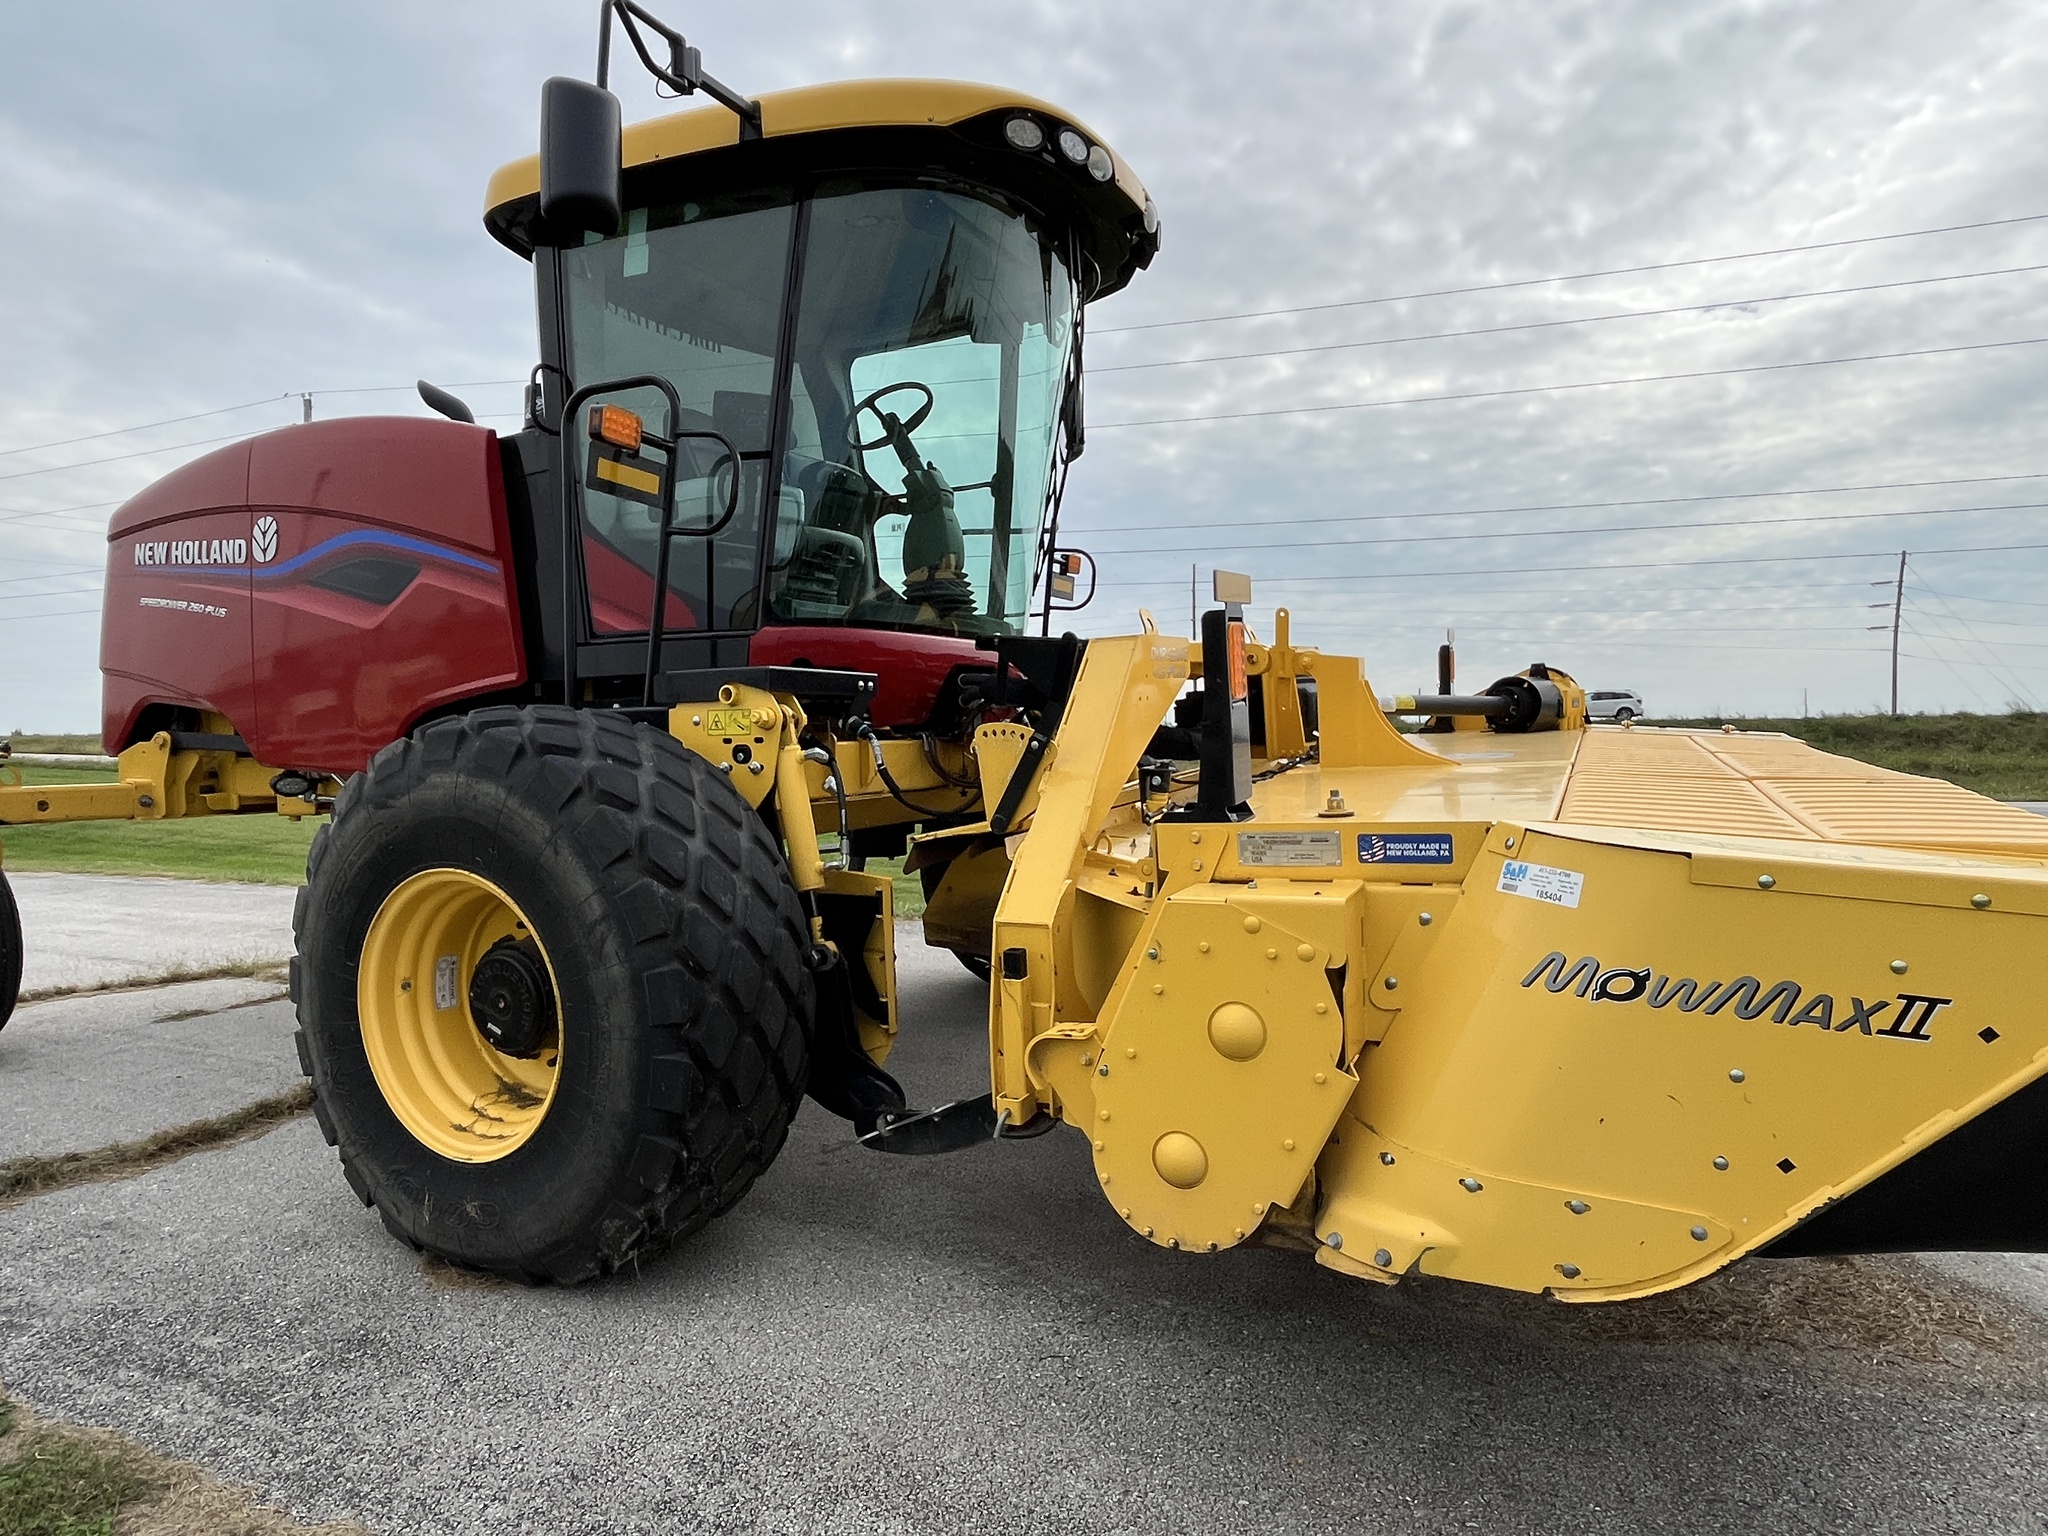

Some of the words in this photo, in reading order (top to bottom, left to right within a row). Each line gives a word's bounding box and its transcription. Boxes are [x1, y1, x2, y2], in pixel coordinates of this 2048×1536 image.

[135, 541, 168, 565] NEW
[172, 539, 246, 564] HOLLAND
[188, 602, 204, 613] 260
[205, 605, 227, 617] PLUS
[1536, 889, 1562, 902] 185404
